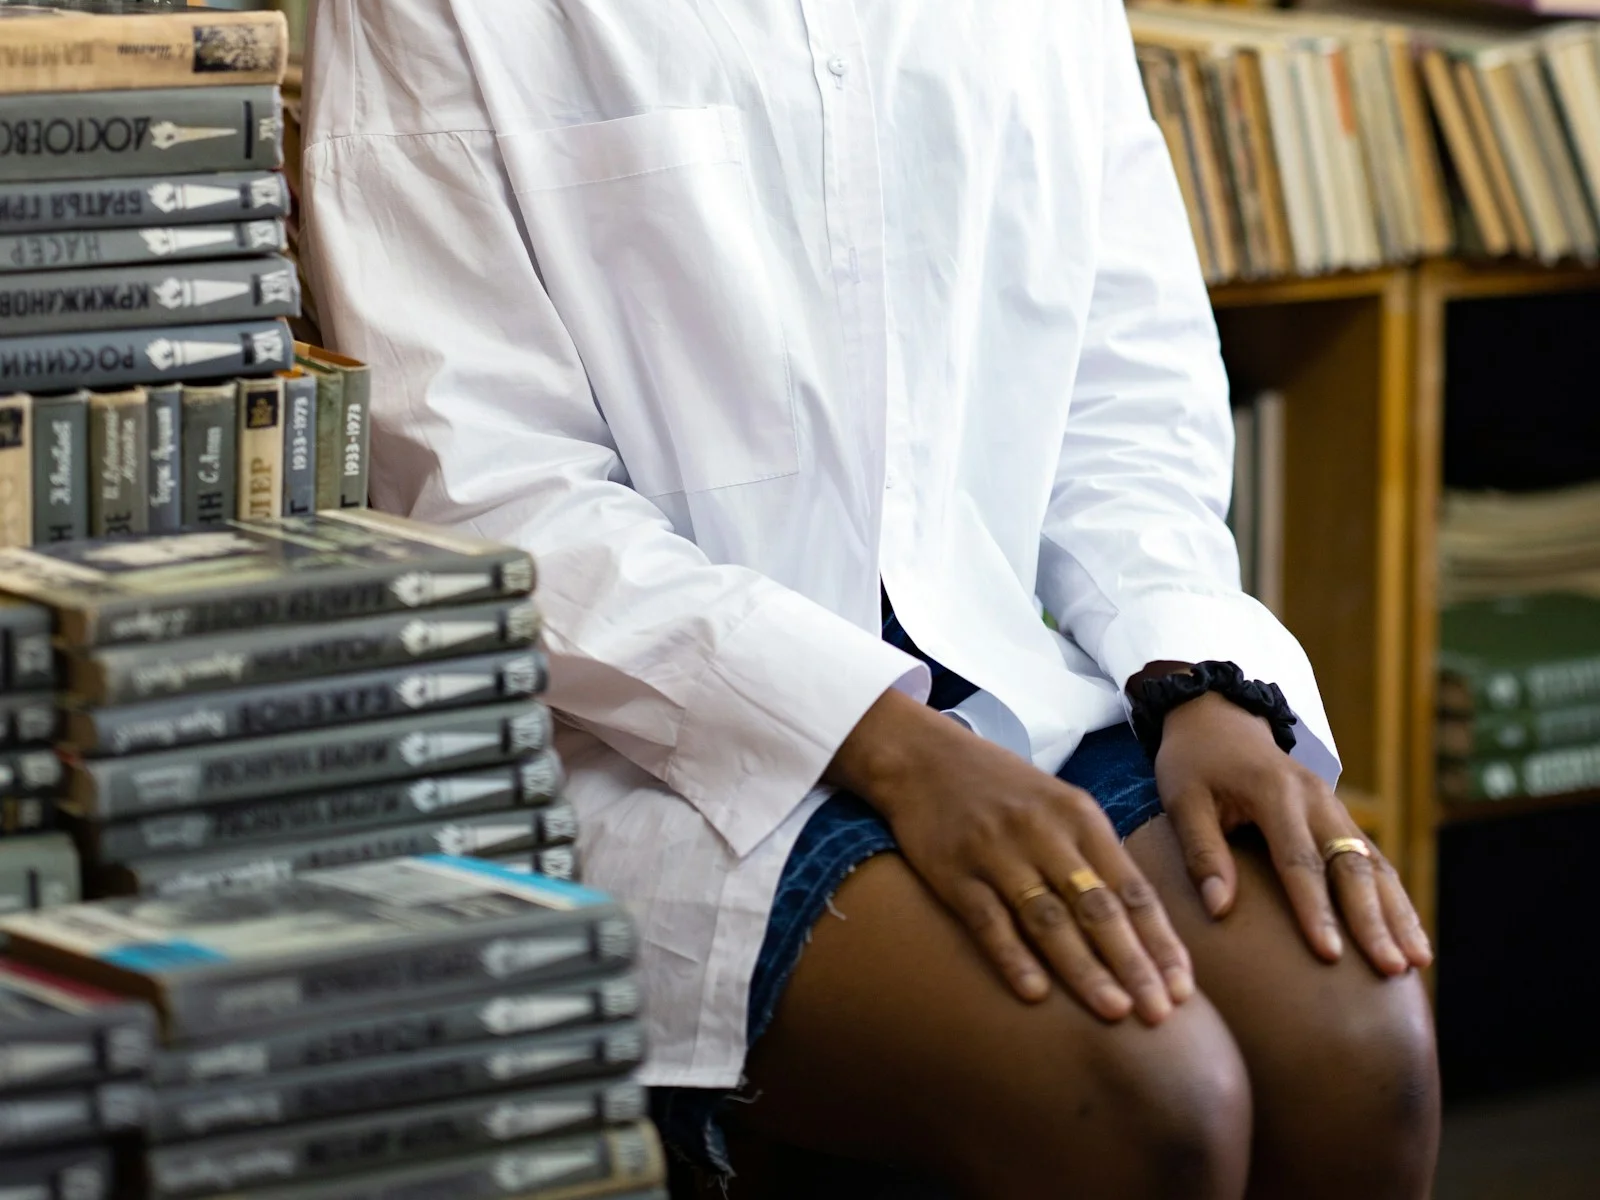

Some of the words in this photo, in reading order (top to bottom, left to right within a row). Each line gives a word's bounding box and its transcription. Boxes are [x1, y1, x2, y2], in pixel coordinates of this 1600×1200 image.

[51, 189, 143, 219] БРАТЬЯ
[11, 236, 102, 266] НАСЕР
[1, 345, 135, 379] РОССИНИ
[292, 397, 309, 471] 1933-1973
[344, 403, 361, 476] 1933-1973
